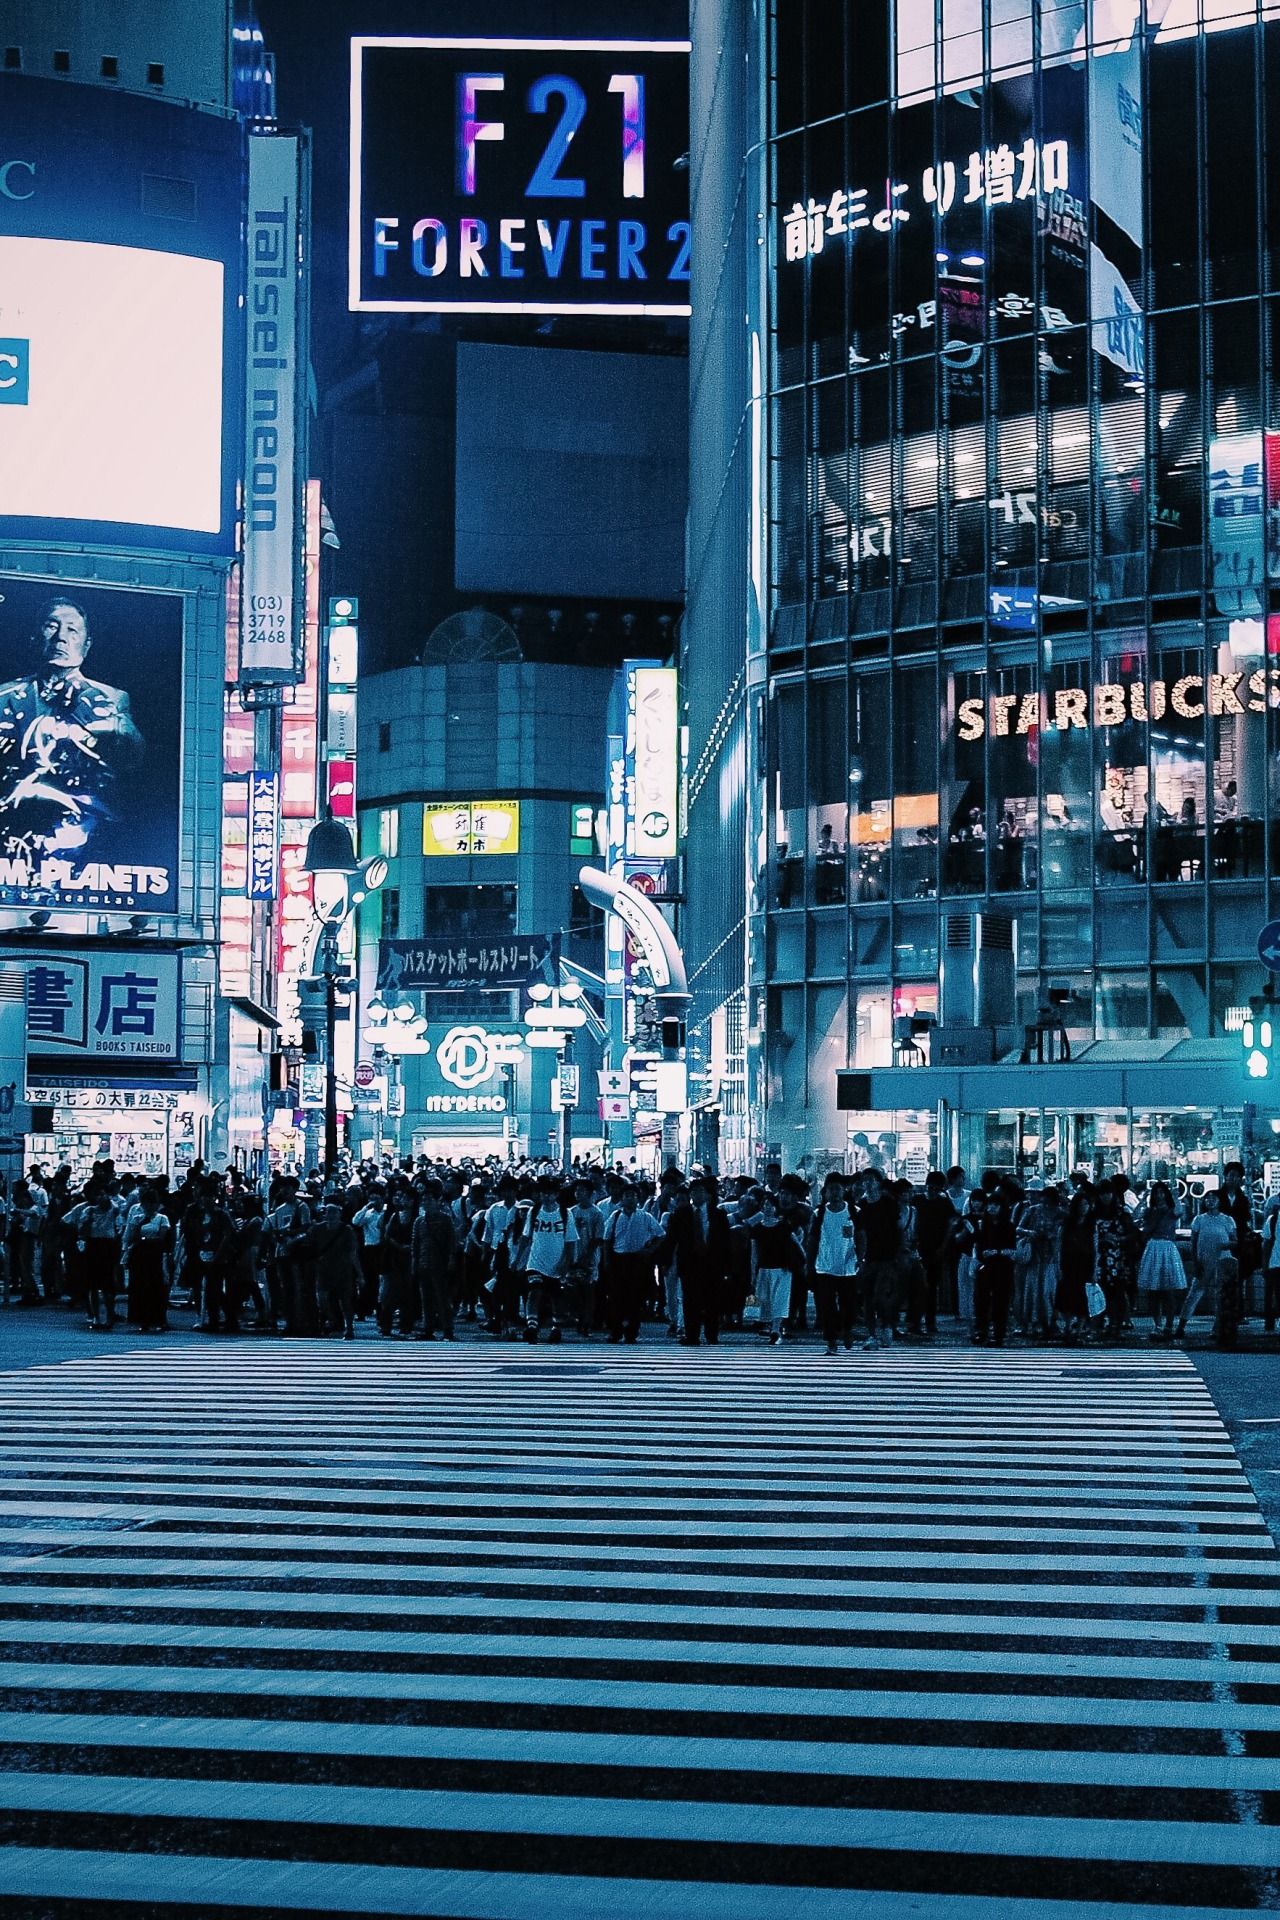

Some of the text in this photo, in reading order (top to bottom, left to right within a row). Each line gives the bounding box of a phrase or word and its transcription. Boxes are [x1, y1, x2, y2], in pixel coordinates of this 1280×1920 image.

[457, 73, 645, 198] F21
[783, 138, 1068, 262] 前年より増加
[374, 217, 648, 280] FOREVER
[252, 196, 288, 532] Taisei neon
[251, 595, 282, 611] (03)
[248, 614, 286, 628] 3719
[248, 630, 286, 643] 2468
[957, 669, 1280, 741] STARBUCKS
[403, 945, 539, 975] バスケットボールストリート
[96, 1041, 171, 1054] BOOKS TAISEIDO
[40, 1078, 109, 1088] TAISEIDO
